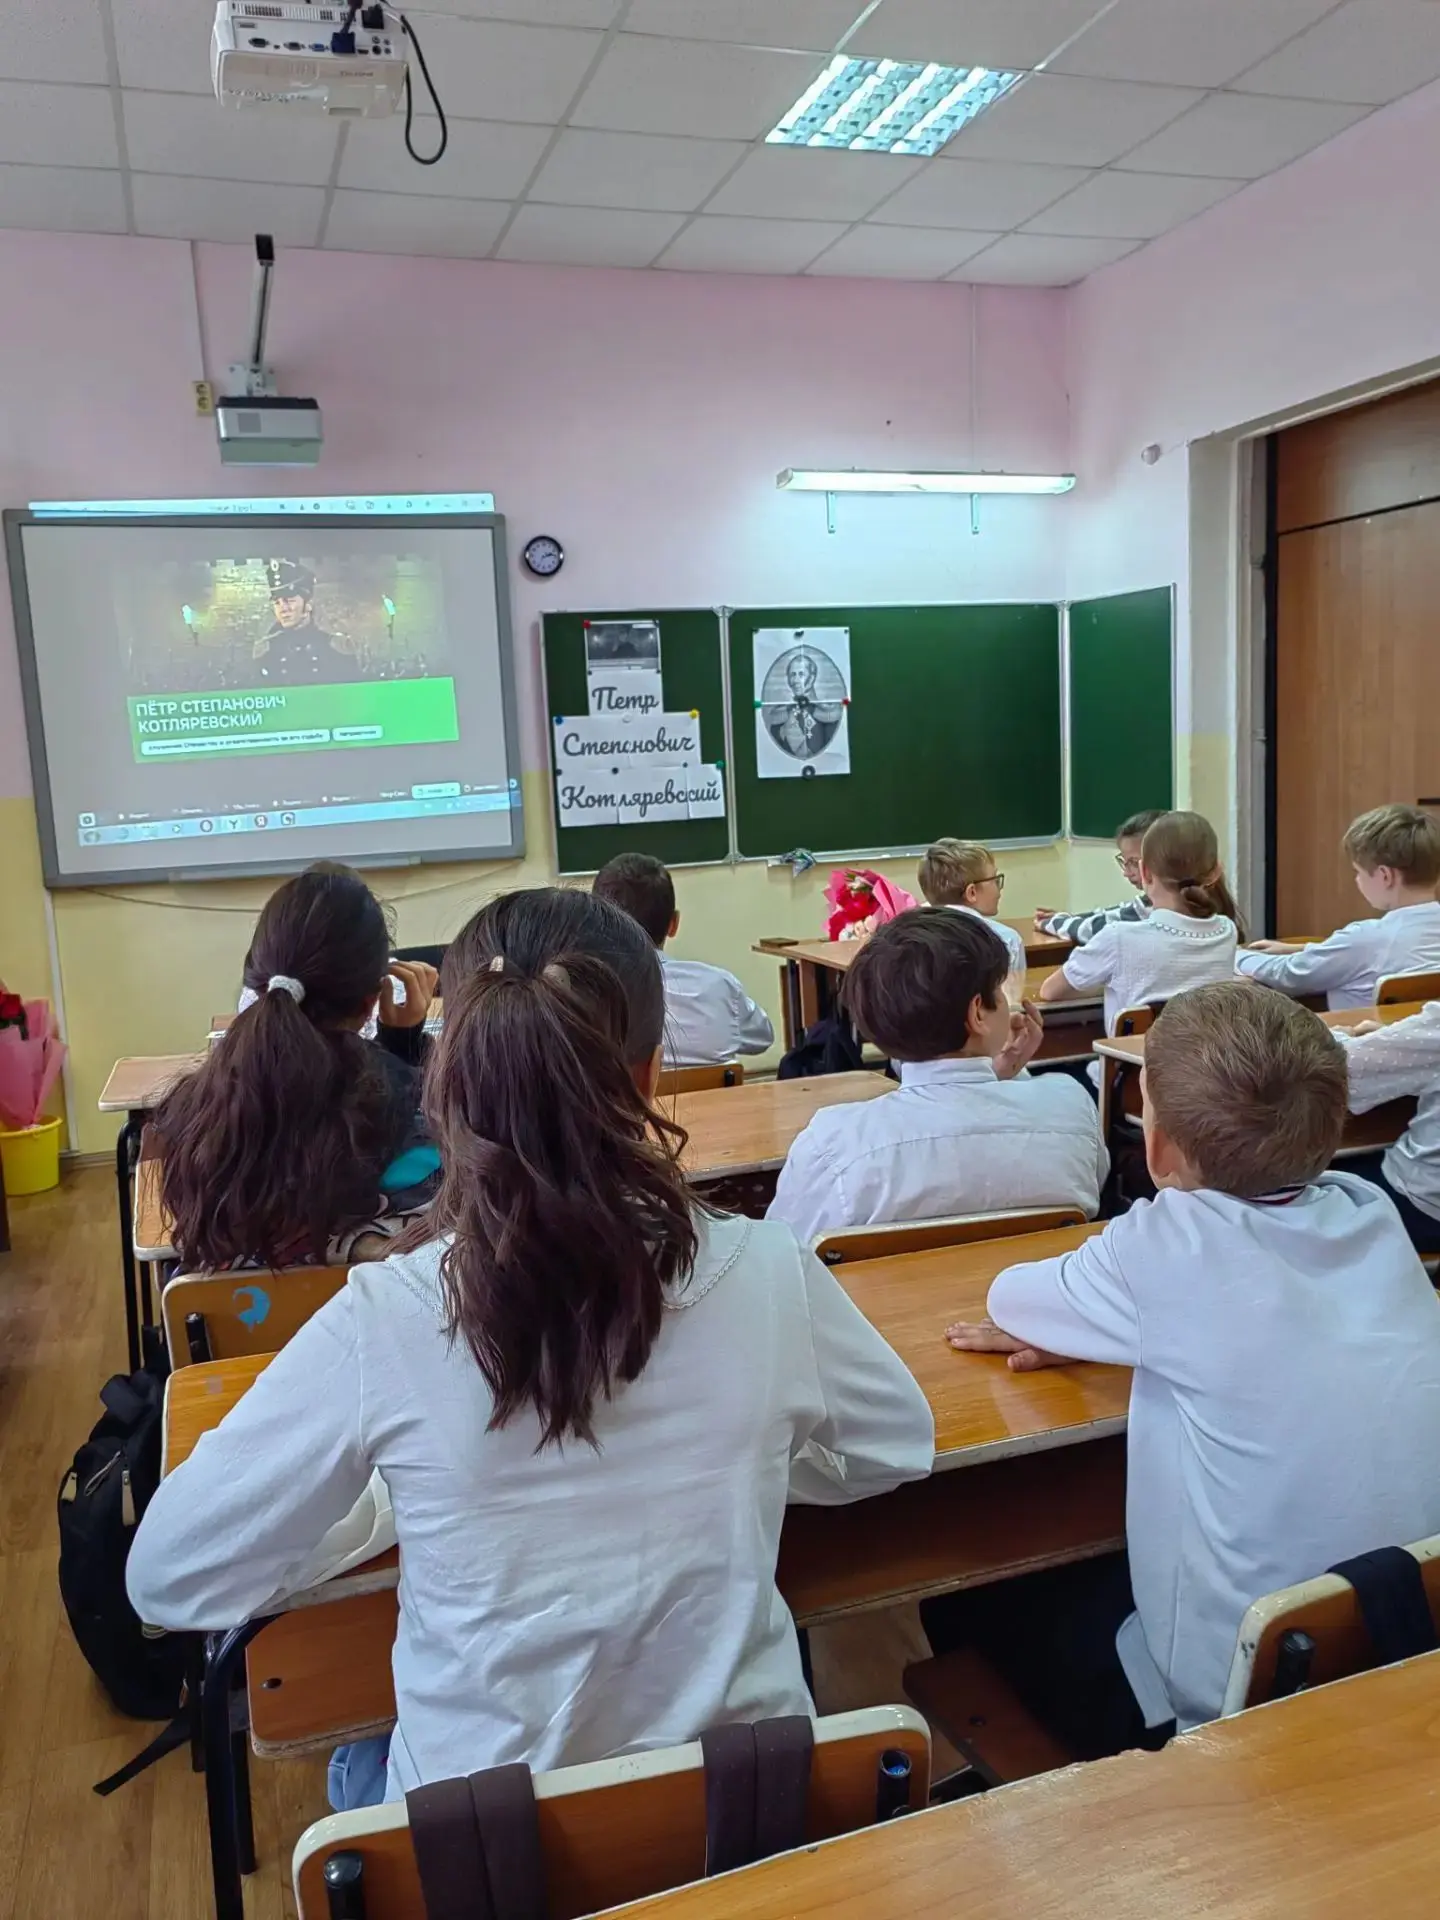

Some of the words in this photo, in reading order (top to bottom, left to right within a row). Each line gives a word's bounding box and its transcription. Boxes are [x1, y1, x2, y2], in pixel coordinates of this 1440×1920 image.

[136, 700, 178, 717] ПЁТР
[181, 695, 286, 715] СТЕПАНОВИЧ
[592, 686, 659, 714] Петр
[138, 710, 263, 733] КОТЛЯРЕВСКИЙ
